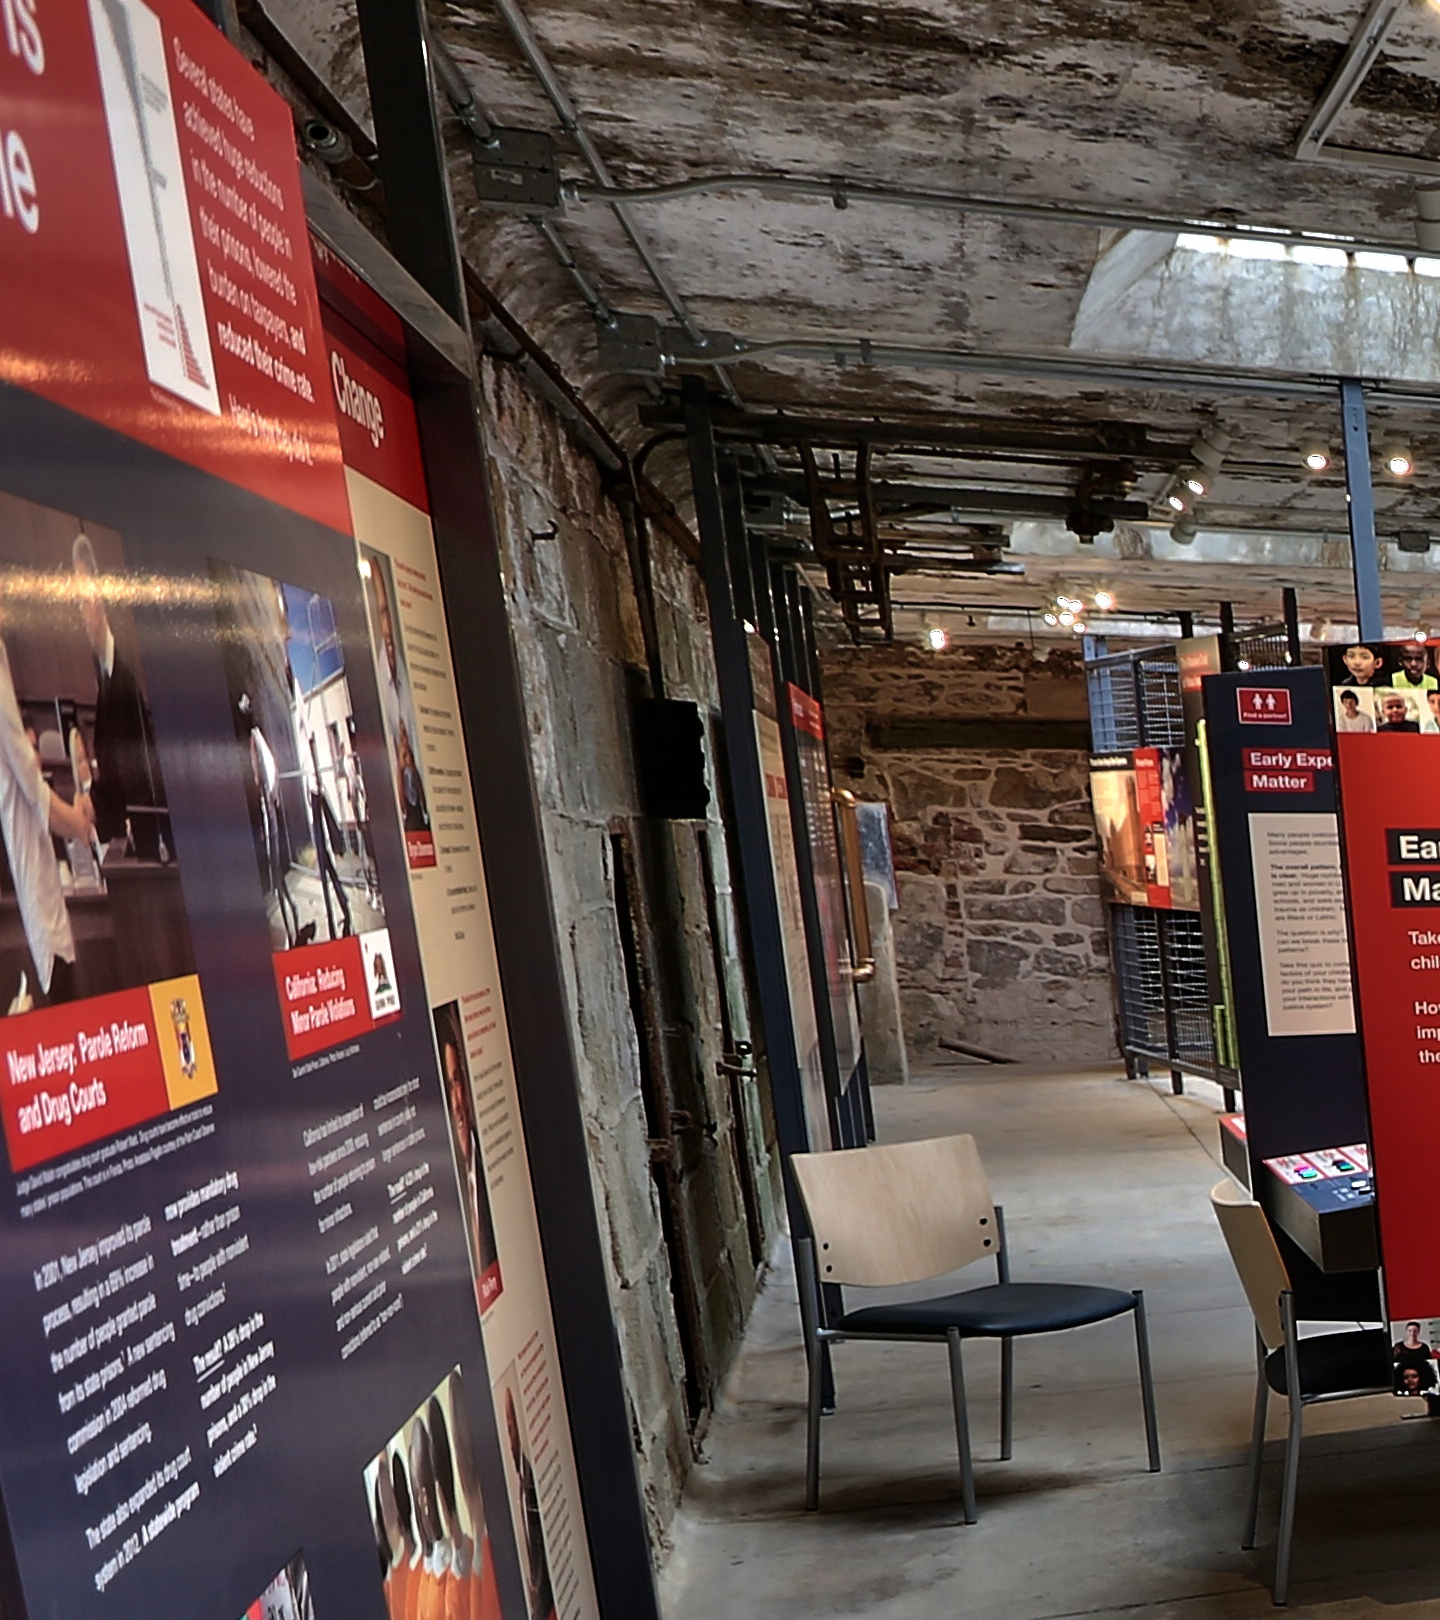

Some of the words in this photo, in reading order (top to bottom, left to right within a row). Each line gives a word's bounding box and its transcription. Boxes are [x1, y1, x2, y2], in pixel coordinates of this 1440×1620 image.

[331, 351, 385, 448] Change
[1250, 752, 1291, 769] Early
[1252, 773, 1307, 790] Matter
[7, 1049, 36, 1084] New
[79, 1027, 112, 1063] Parole
[112, 1021, 148, 1053] Reform
[18, 1094, 41, 1133] and
[41, 1090, 71, 1126] Drug
[70, 1077, 107, 1114] Courts
